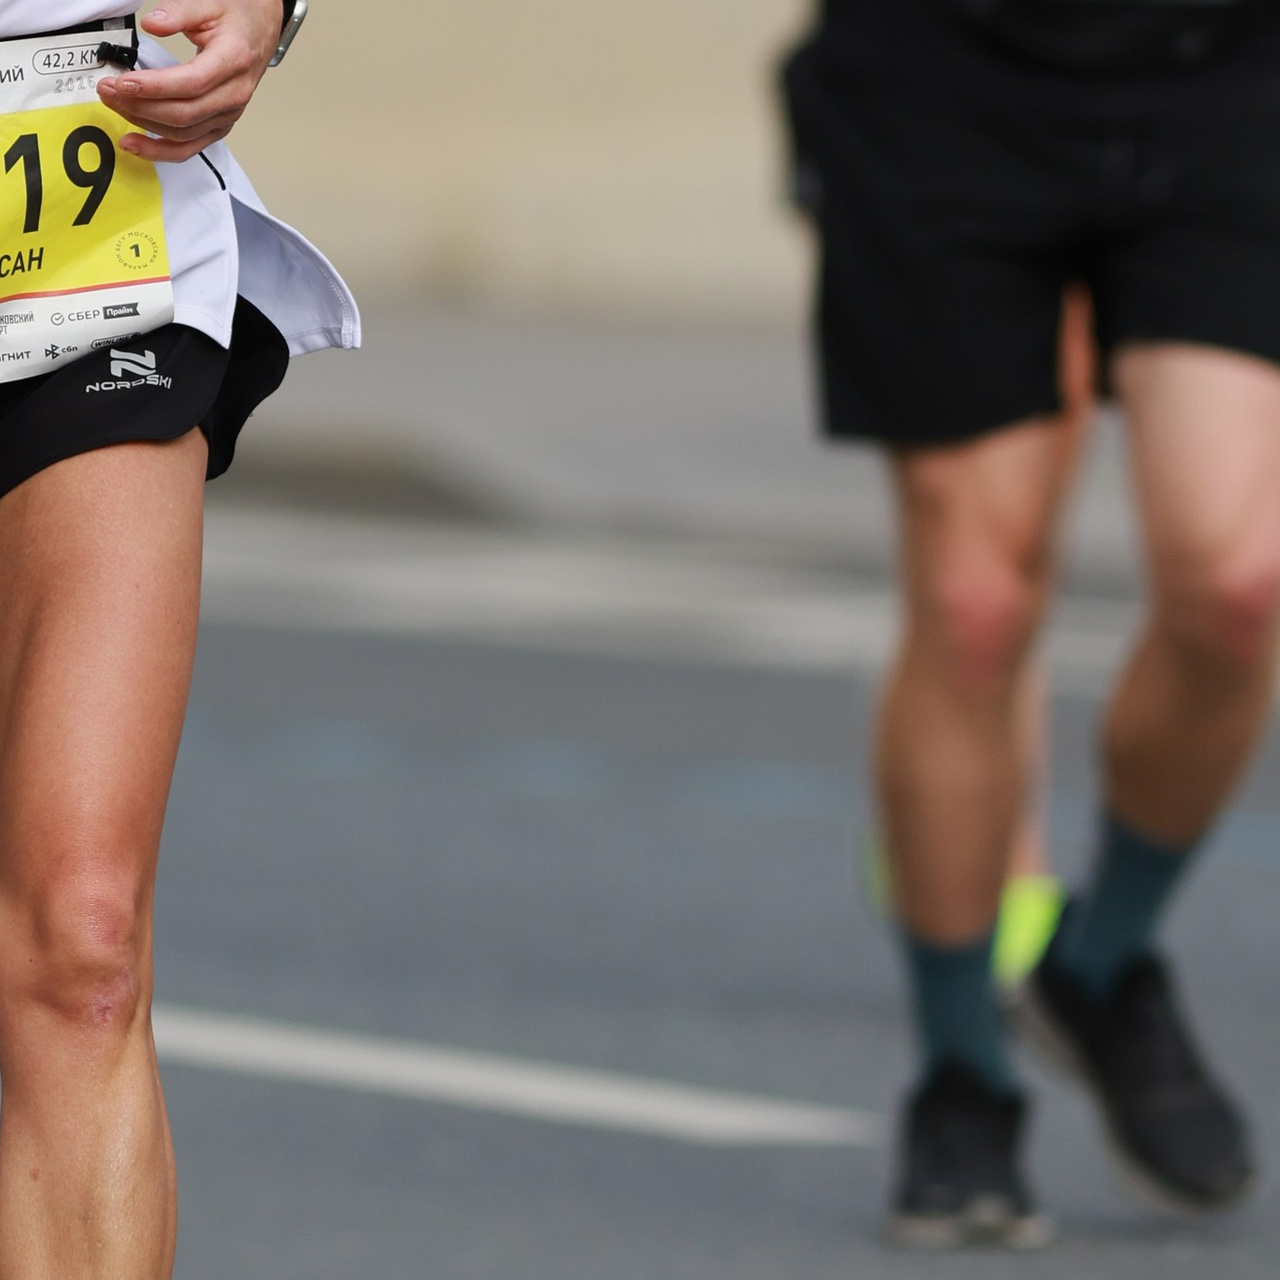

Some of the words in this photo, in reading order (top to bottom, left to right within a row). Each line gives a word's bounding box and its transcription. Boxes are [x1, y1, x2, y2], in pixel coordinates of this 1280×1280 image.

[42, 51, 75, 69] 42,2
[129, 243, 140, 258] 1
[68, 309, 100, 322] СБЕР
[106, 306, 134, 317] Прайм
[61, 345, 78, 354] сбп
[85, 374, 172, 393] NORDSKI
